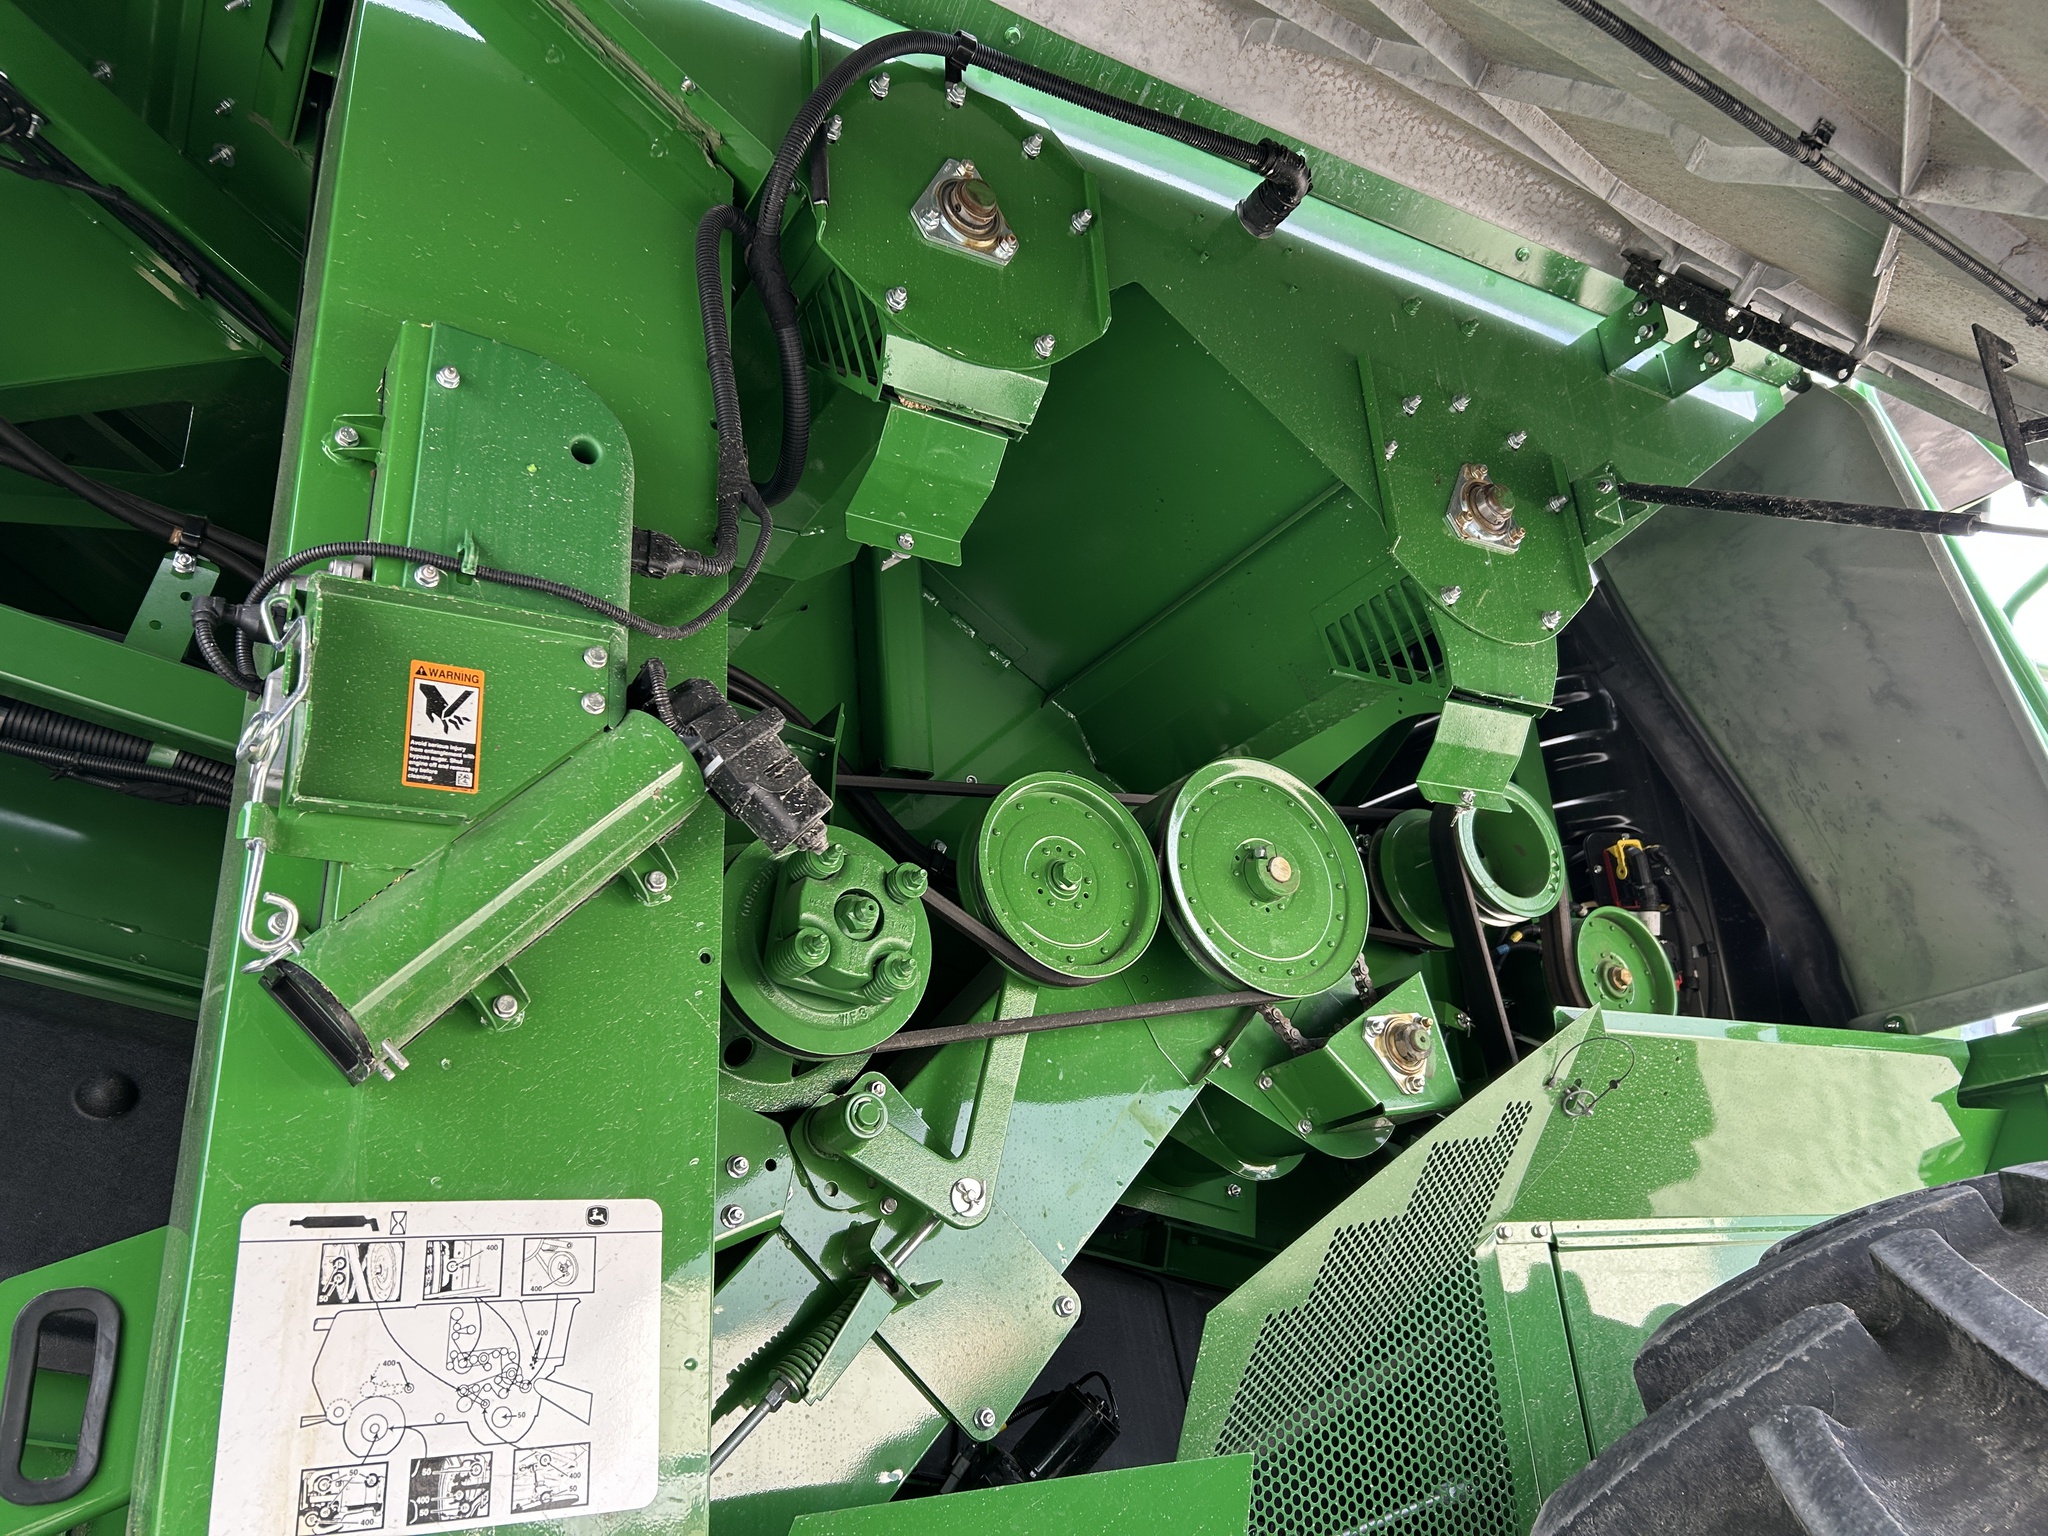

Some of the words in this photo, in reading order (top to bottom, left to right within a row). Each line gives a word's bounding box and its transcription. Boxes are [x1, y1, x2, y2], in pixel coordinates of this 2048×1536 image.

[429, 668, 479, 684] WARNING
[424, 749, 462, 758] entanglement
[408, 773, 433, 781] cleaning.
